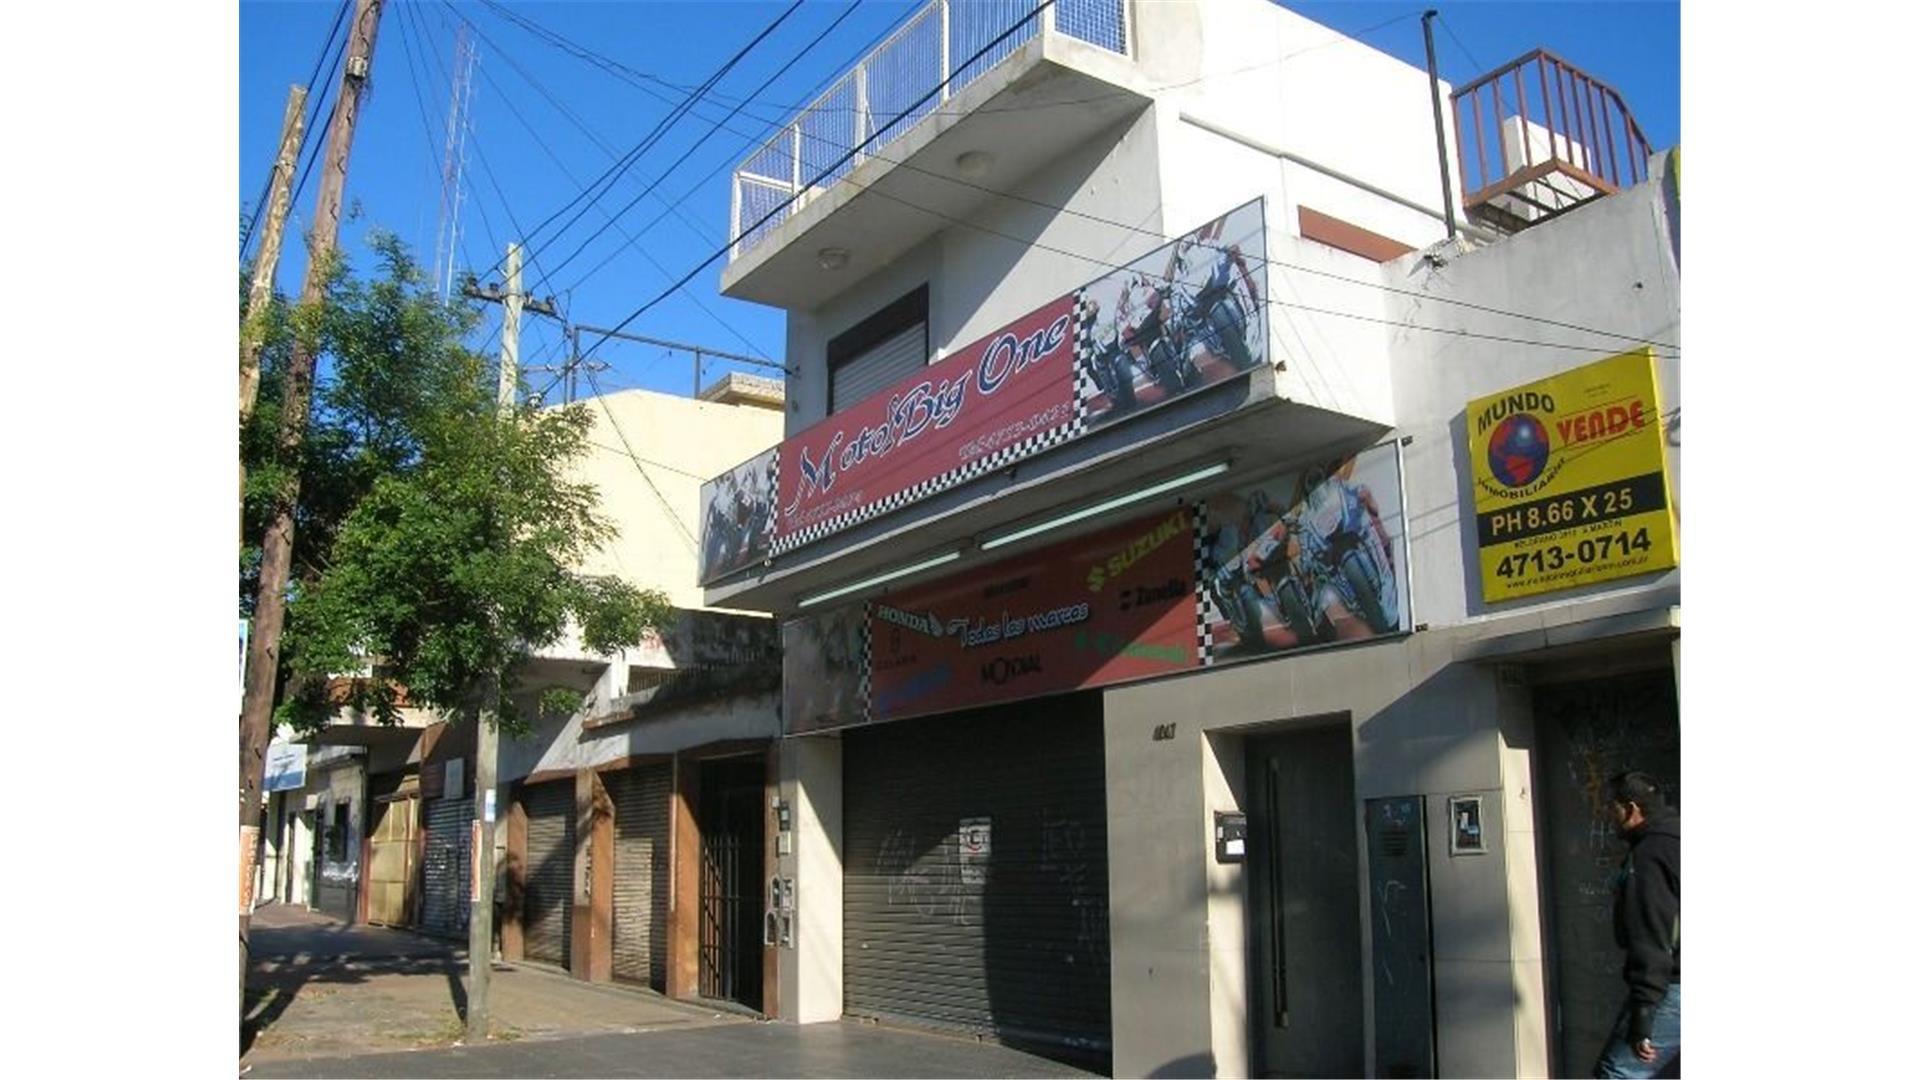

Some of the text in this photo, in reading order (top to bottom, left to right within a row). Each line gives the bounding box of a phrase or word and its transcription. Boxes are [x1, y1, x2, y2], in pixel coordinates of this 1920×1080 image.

[896, 369, 973, 448] Big
[977, 313, 1071, 395] One
[1478, 392, 1555, 436] MUNDO
[1556, 399, 1645, 449] VENDE
[1491, 487, 1633, 537] PH 8.66 X 25
[1106, 510, 1185, 577] SUZUKI
[1496, 527, 1652, 579] 4713-0714
[878, 603, 930, 635] HONDA
[946, 602, 1090, 649] Todas las marcas
